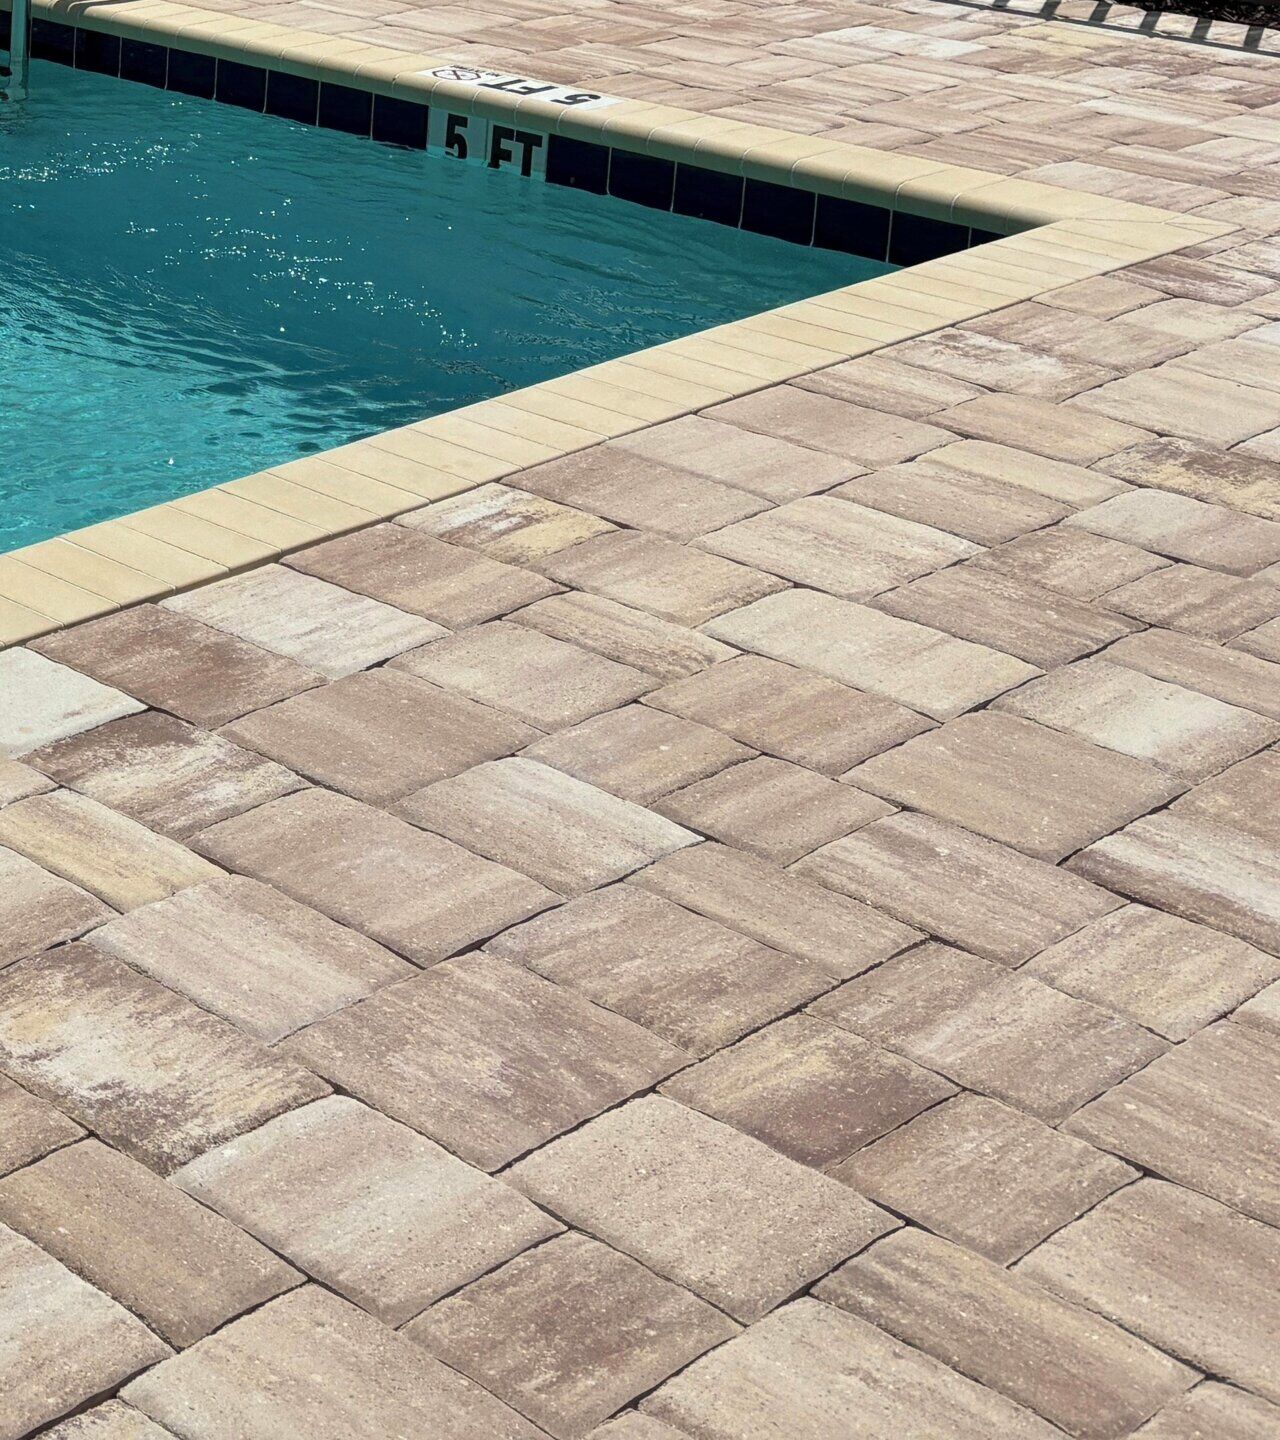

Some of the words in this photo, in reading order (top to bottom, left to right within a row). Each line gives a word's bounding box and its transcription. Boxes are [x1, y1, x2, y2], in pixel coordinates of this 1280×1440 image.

[478, 79, 559, 95] FT
[550, 93, 602, 105] 5
[445, 113, 468, 160] 5
[487, 124, 543, 177] FT
